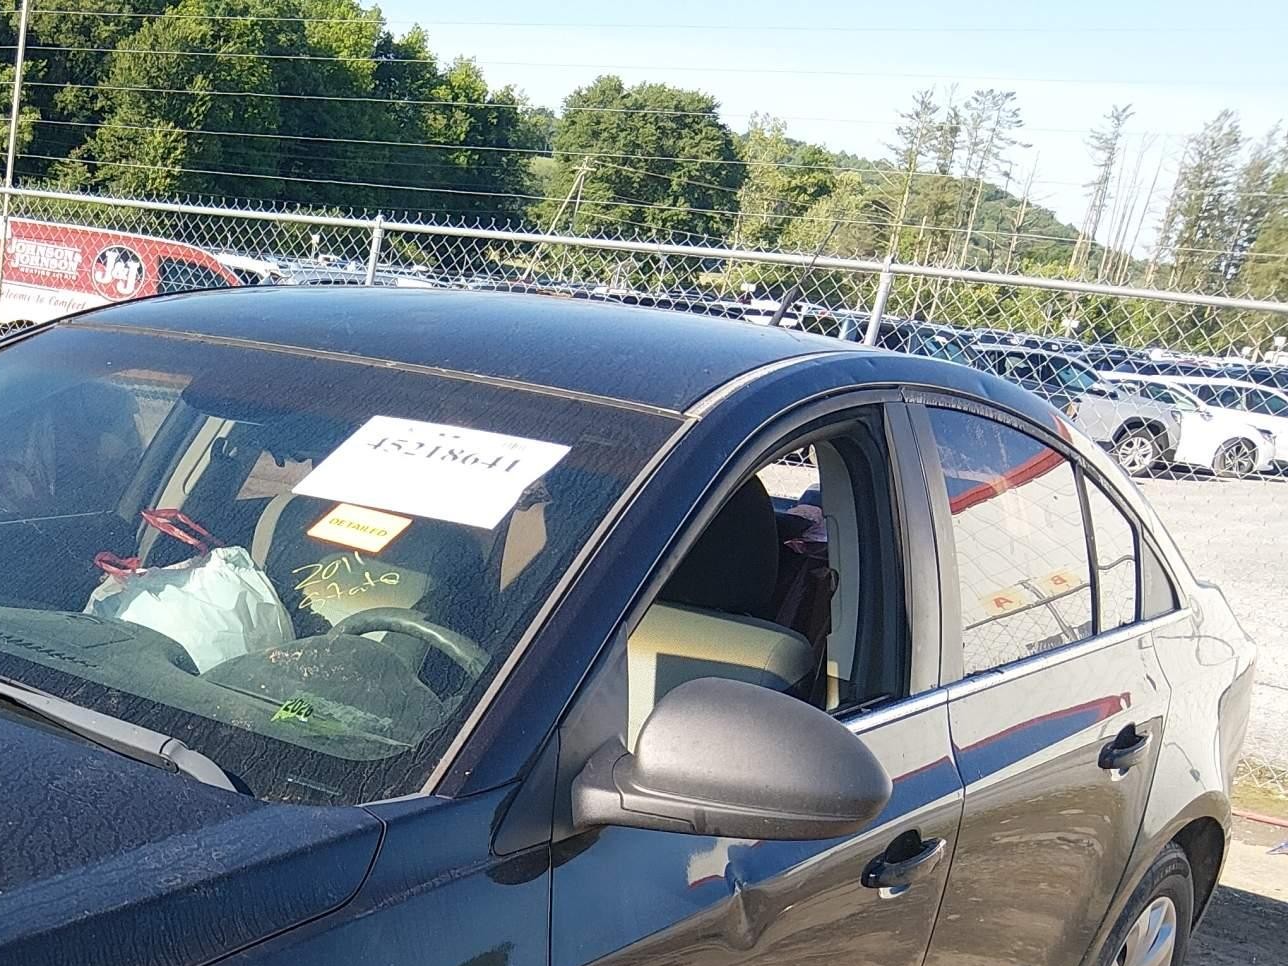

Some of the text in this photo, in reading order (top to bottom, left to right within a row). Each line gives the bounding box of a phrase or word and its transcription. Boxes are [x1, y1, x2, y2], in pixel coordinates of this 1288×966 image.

[11, 253, 79, 273] JOHNSON
[95, 250, 140, 295] J&J
[367, 436, 521, 473] 45218641
[328, 517, 388, 538] DETAILED
[292, 550, 365, 591] 2011
